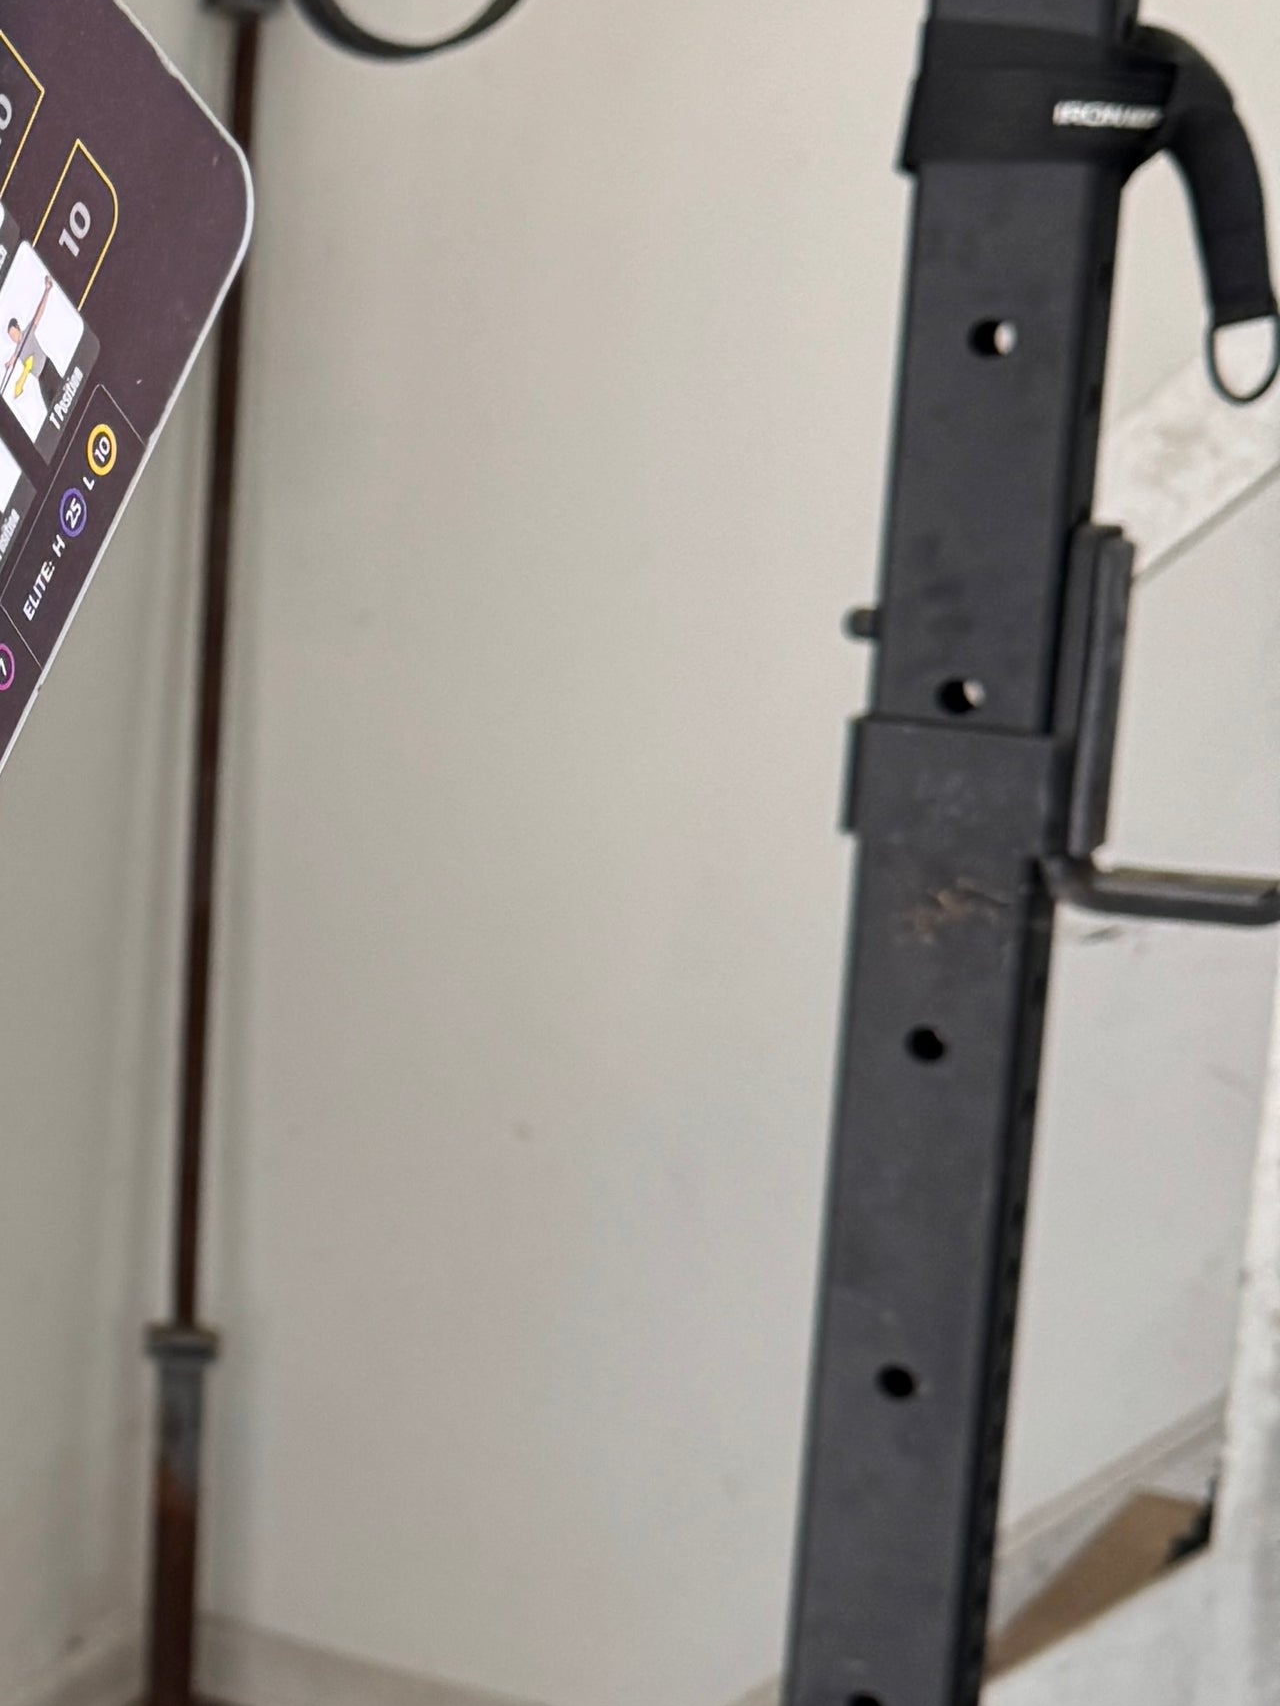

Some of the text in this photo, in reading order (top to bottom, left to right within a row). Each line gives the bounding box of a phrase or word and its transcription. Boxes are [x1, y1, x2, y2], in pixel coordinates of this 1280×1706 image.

[58, 201, 91, 256] 10
[23, 560, 55, 621] ELITE:
[52, 534, 66, 558] H
[65, 497, 82, 529] 25
[93, 436, 111, 463] 10
